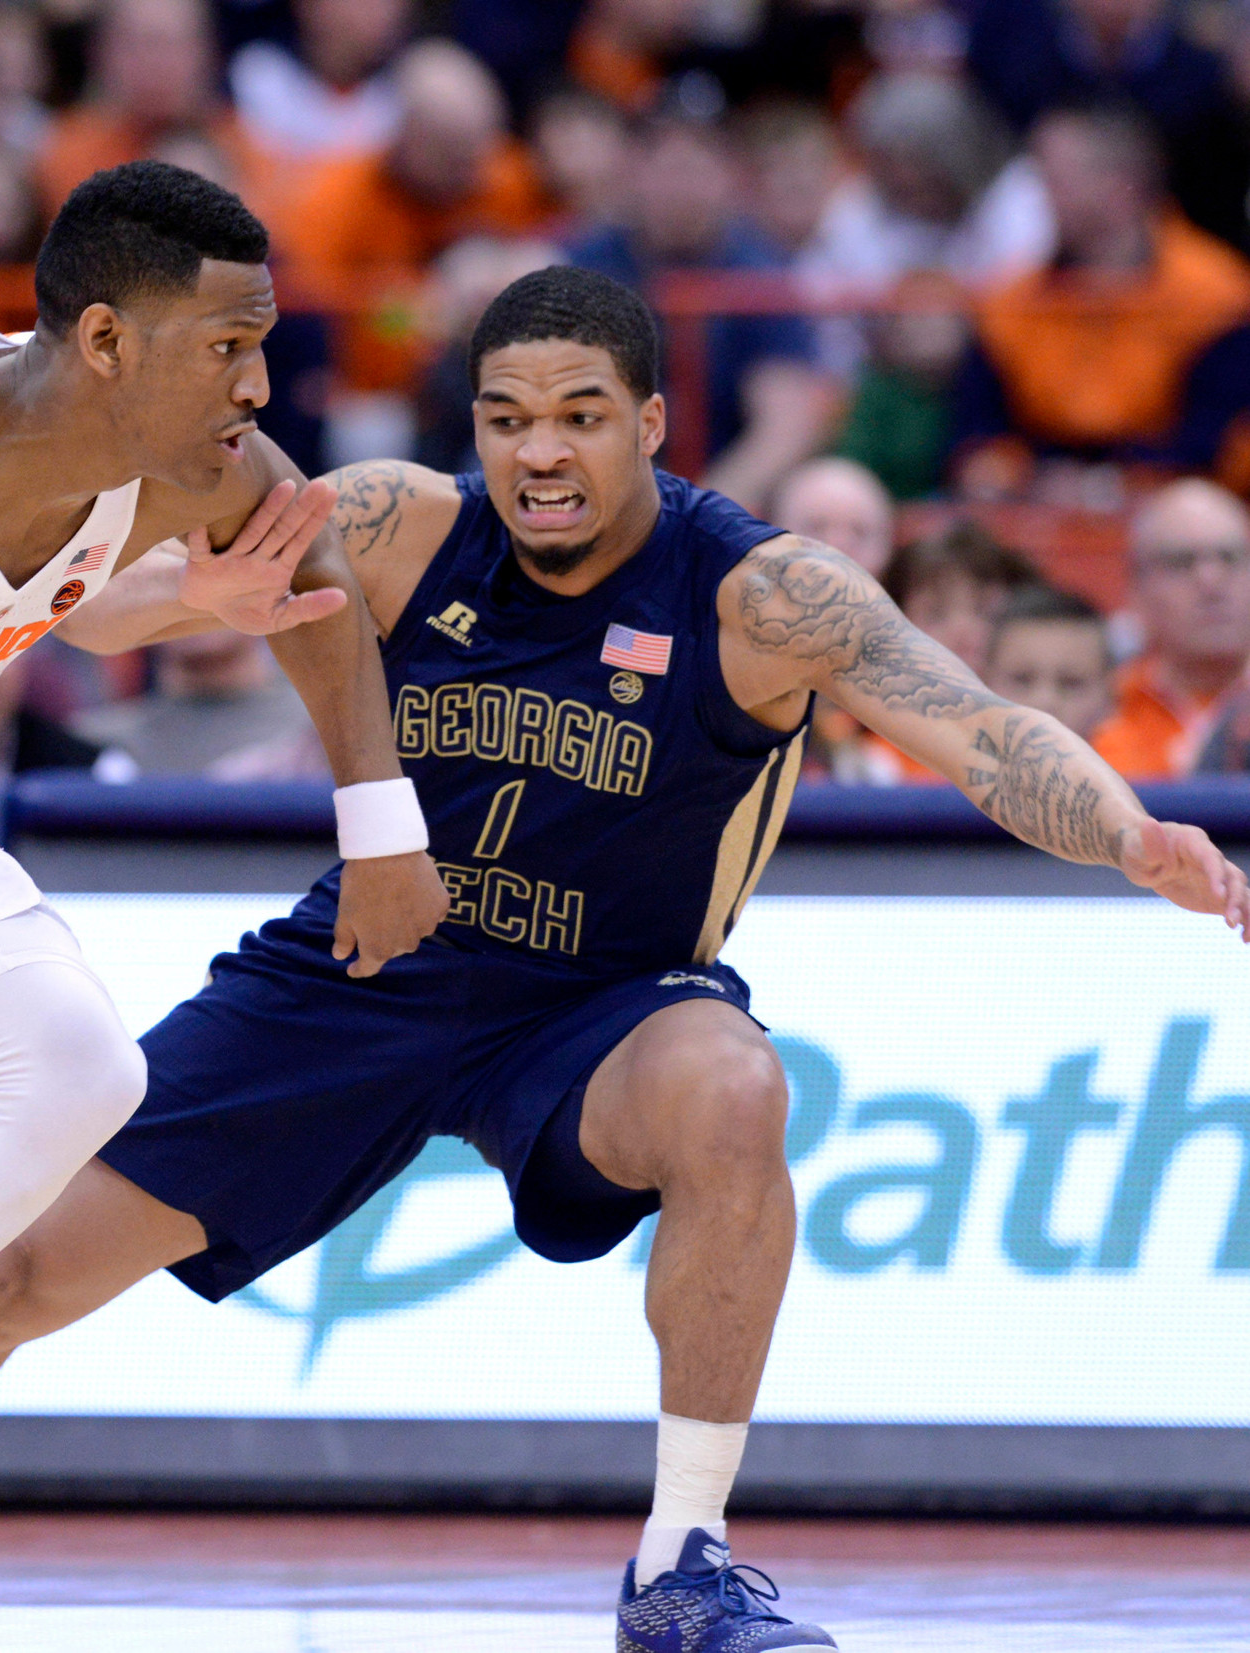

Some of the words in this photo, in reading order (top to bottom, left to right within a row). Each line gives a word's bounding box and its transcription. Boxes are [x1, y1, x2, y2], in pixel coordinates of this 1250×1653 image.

[425, 615, 473, 648] RUSSELL
[393, 683, 652, 797] GEORGIA
[473, 779, 527, 860] 1
[432, 861, 584, 957] ECH
